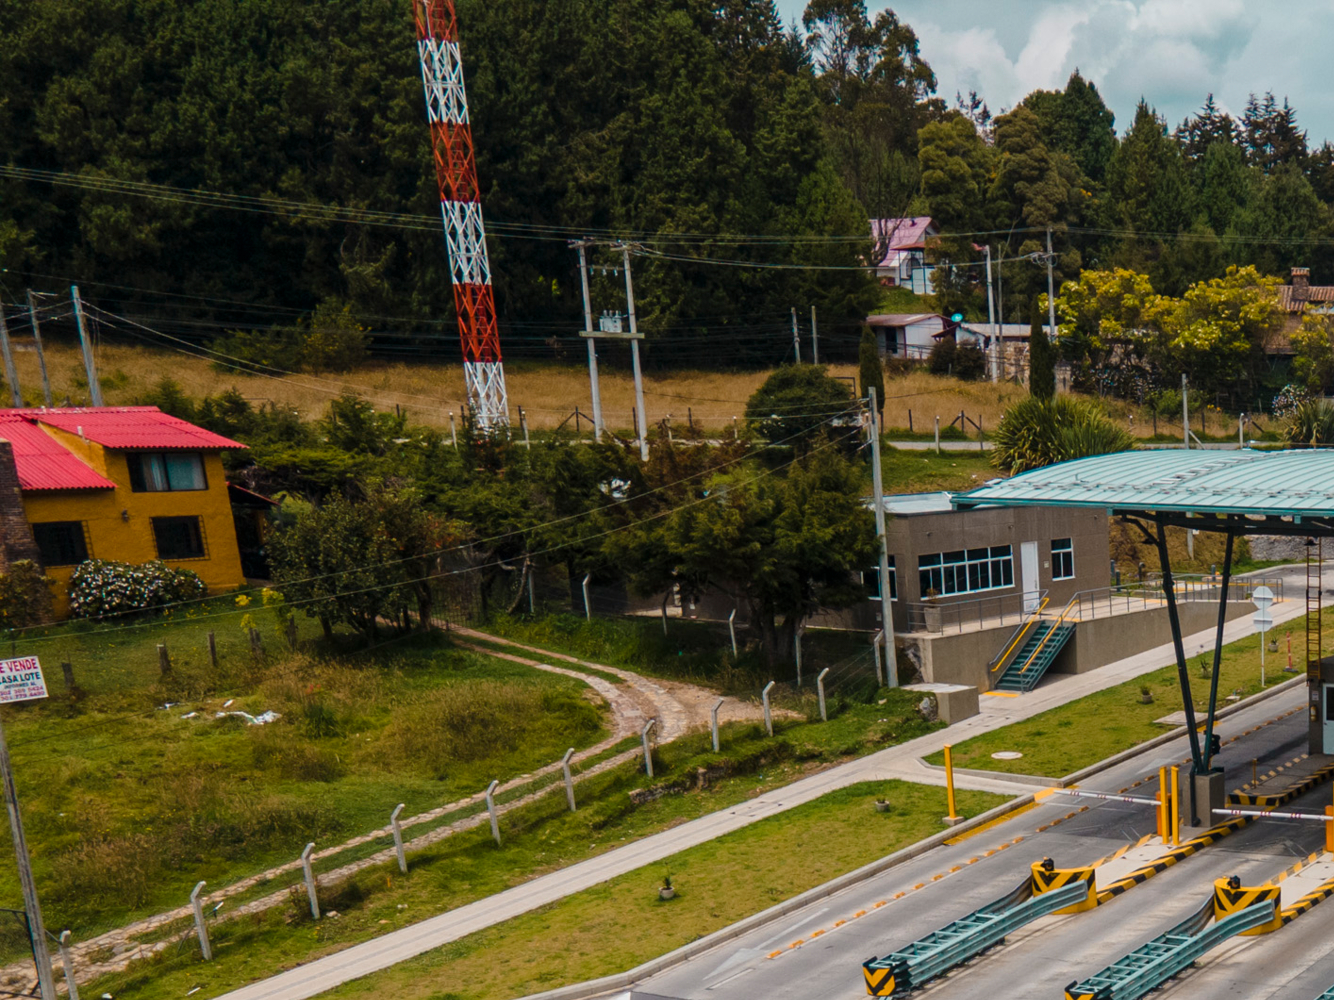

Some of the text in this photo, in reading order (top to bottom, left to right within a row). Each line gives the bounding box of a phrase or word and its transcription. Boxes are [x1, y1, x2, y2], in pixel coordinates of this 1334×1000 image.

[6, 658, 38, 672] VENDE
[0, 672, 41, 685] ASA LOTE
